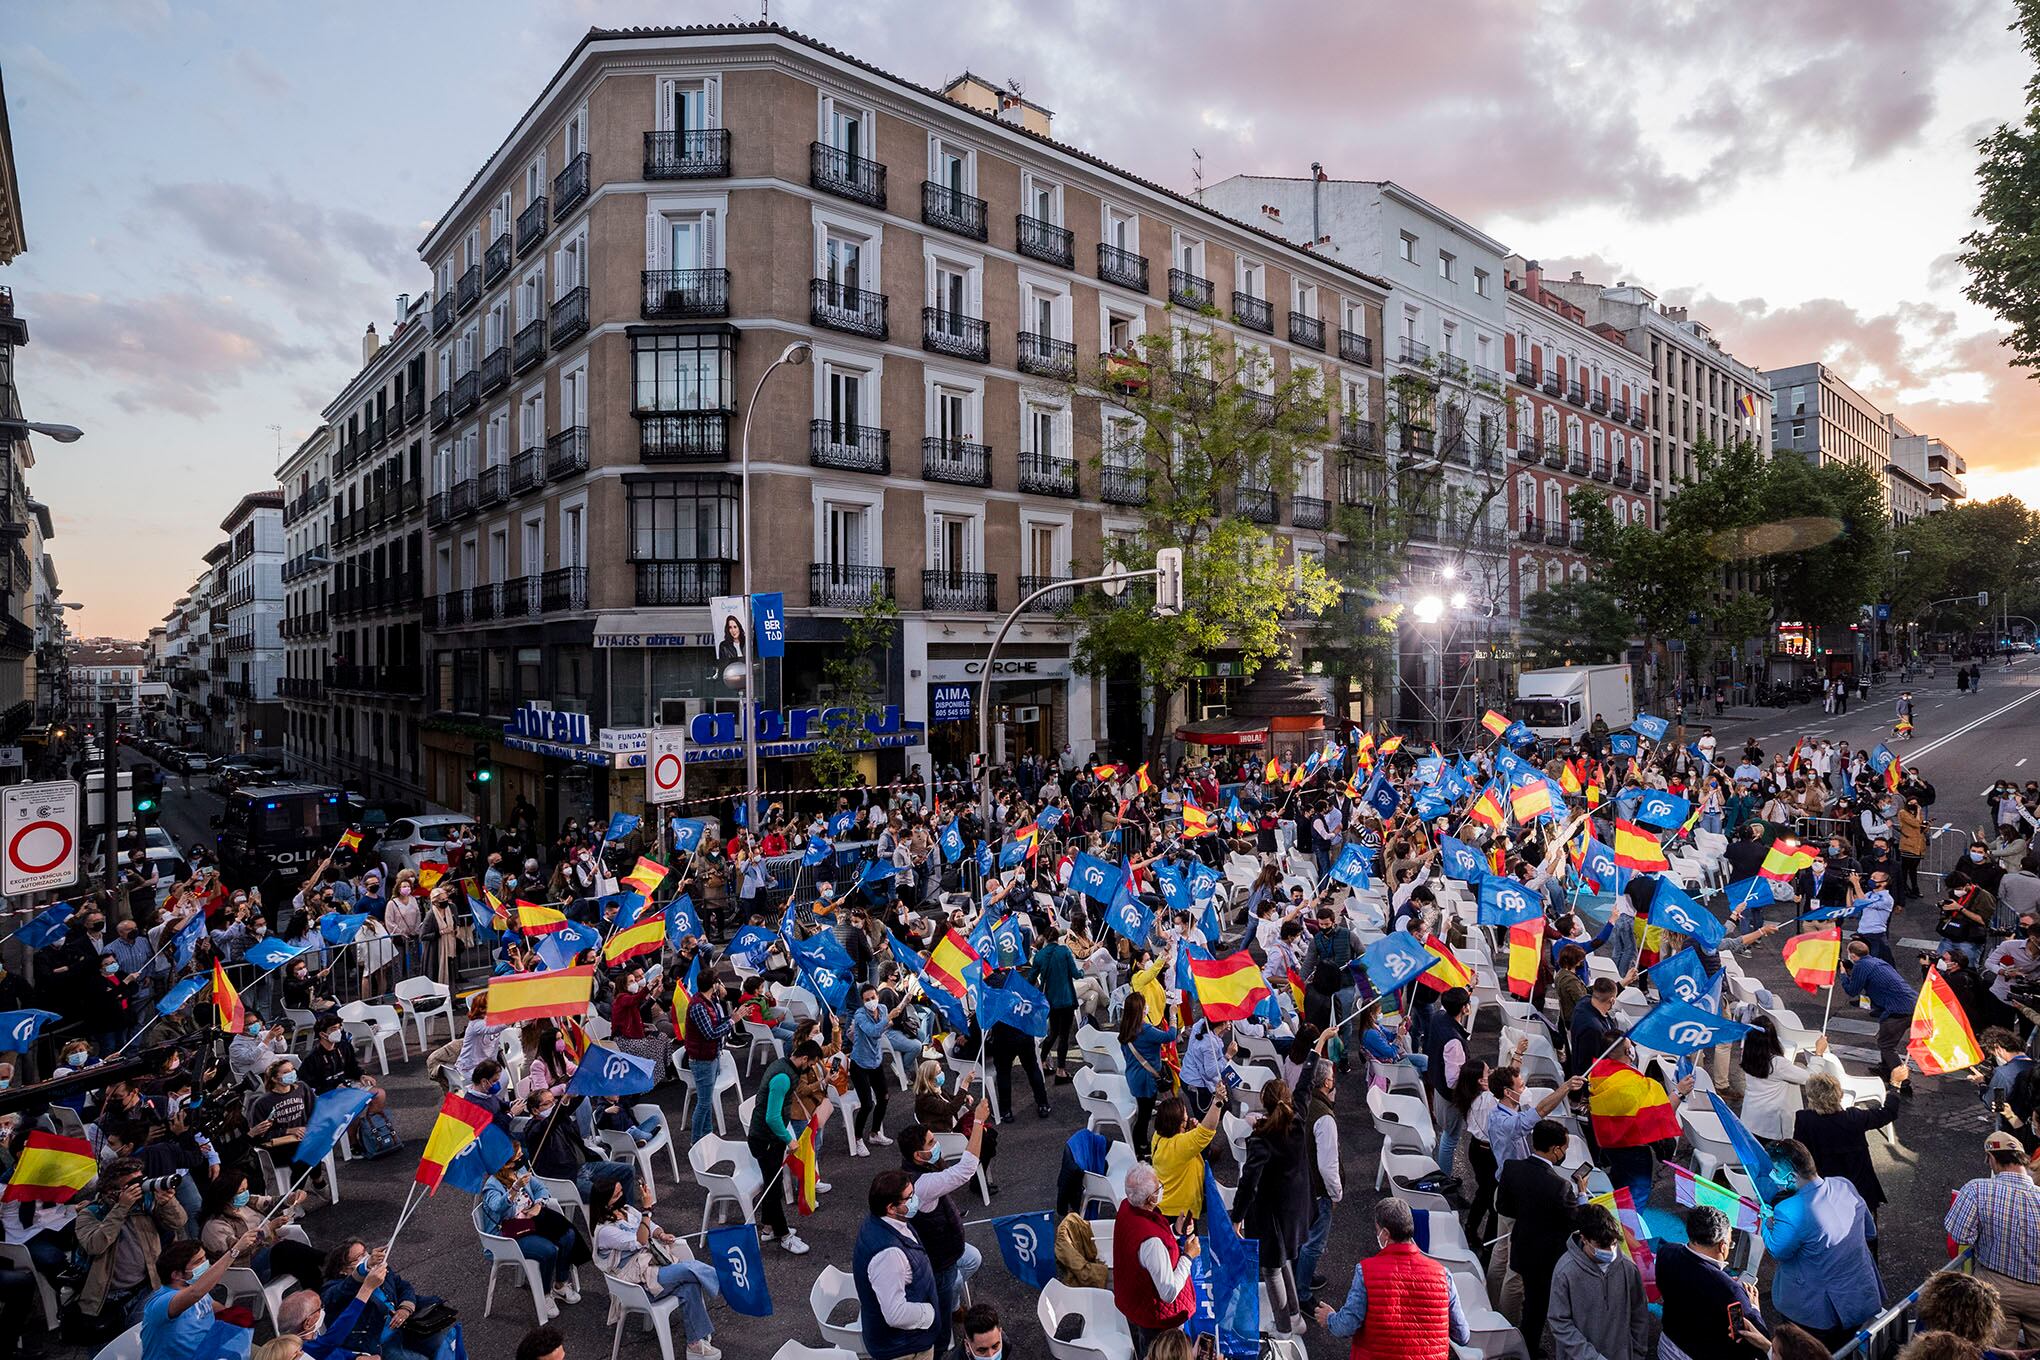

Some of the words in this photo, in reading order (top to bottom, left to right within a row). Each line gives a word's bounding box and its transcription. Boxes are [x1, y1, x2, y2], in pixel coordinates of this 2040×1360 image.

[764, 620, 781, 630] BER
[598, 634, 640, 646] VIAJES
[646, 633, 686, 646] abreu
[765, 631, 782, 641] TAD
[935, 688, 971, 700] AIMA
[935, 700, 970, 709] DISPONIBLE
[514, 701, 590, 745] abreu
[690, 700, 900, 745] abreu
[10, 876, 38, 885] EXCEPTO
[20, 878, 62, 889] AUTORIZADOS
[1504, 896, 1526, 913] pp
[1676, 1027, 1713, 1047] pp
[608, 1059, 631, 1080] pp
